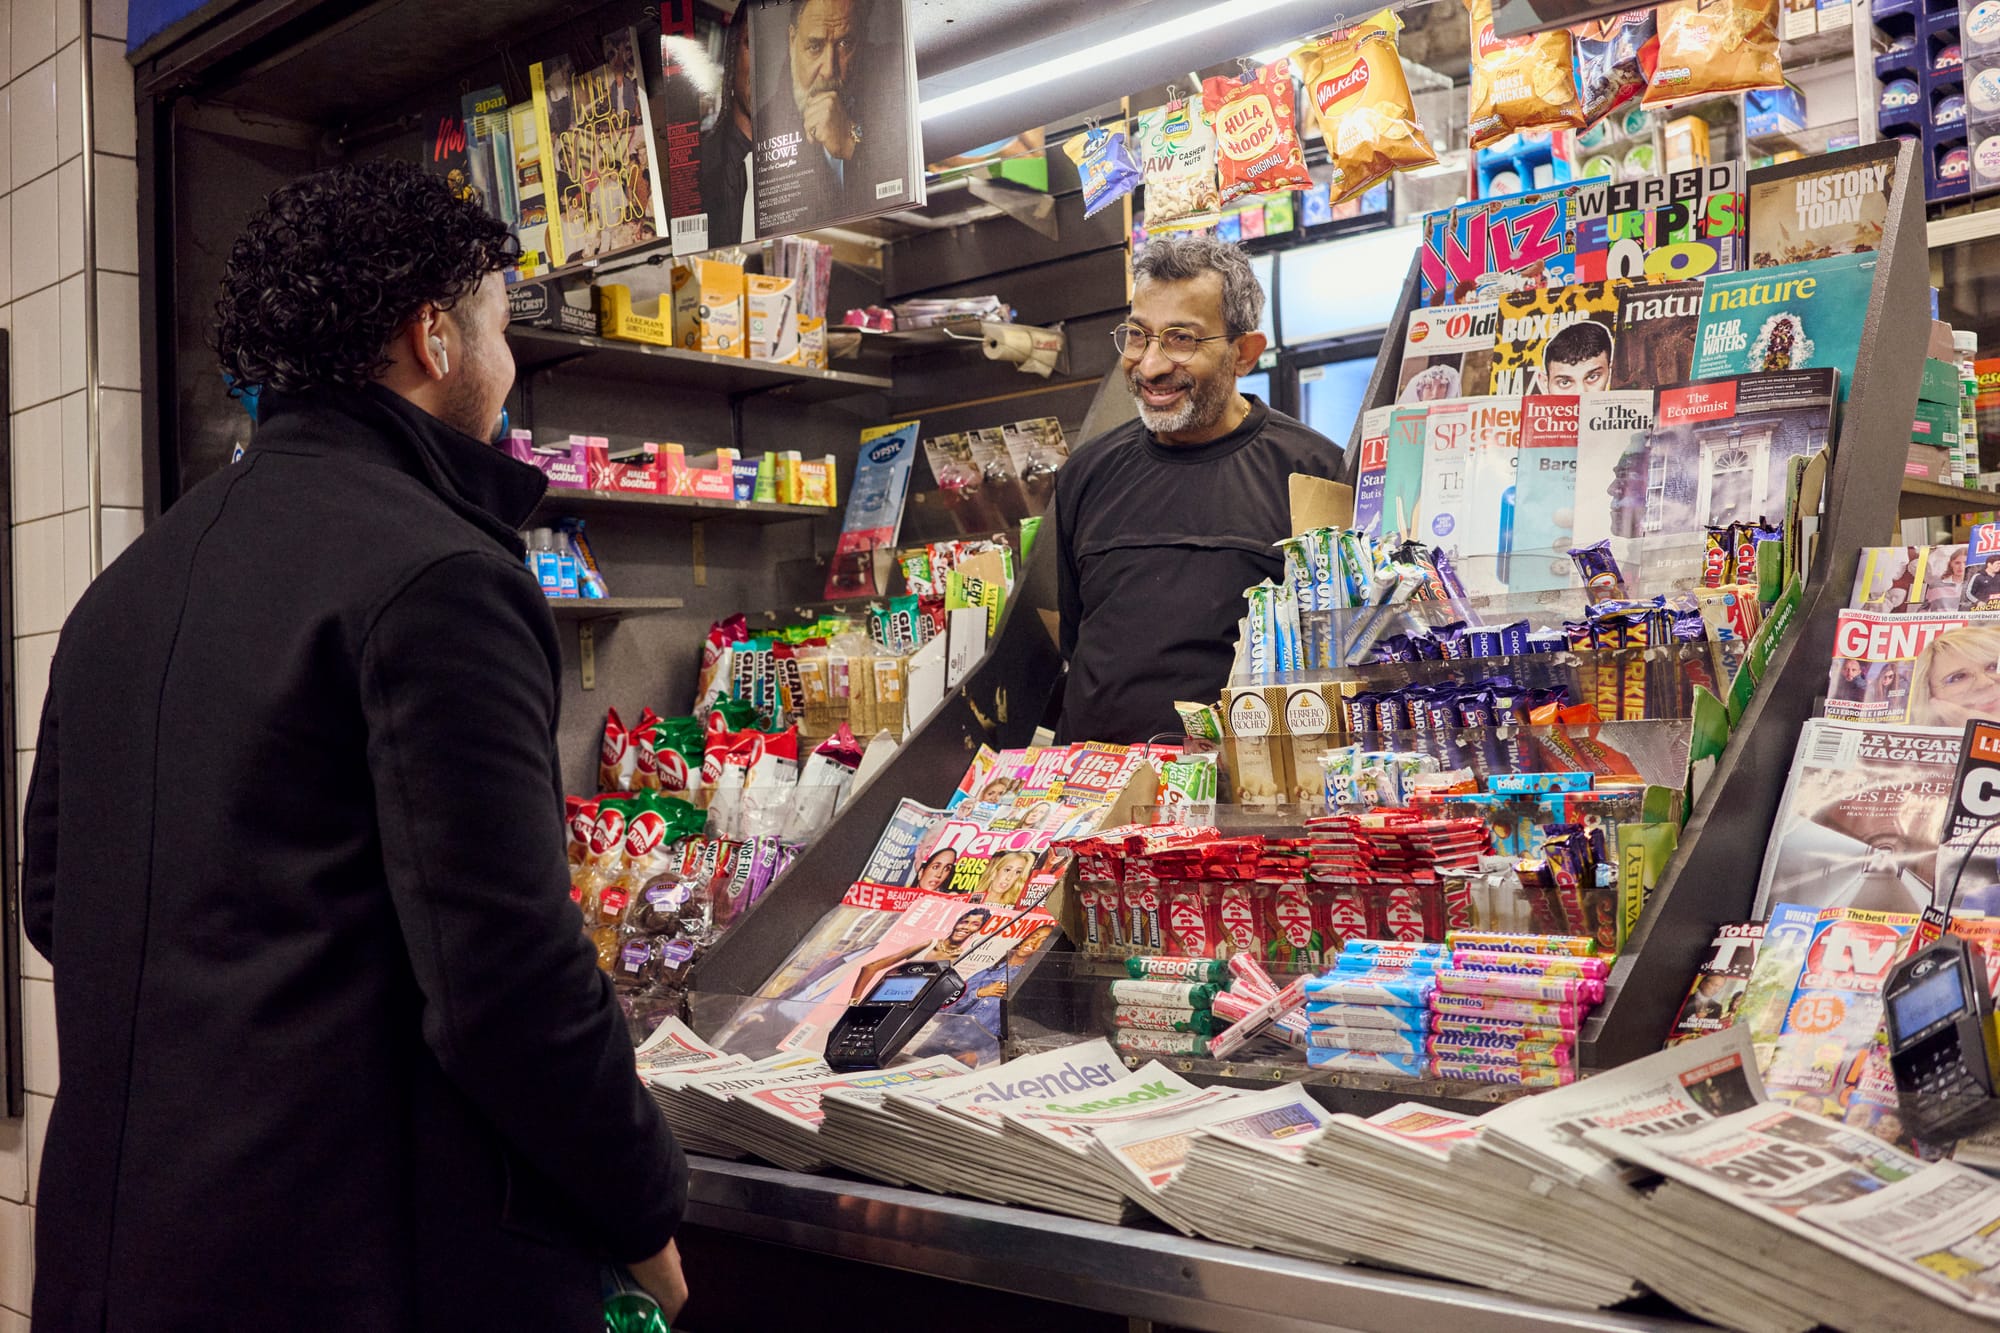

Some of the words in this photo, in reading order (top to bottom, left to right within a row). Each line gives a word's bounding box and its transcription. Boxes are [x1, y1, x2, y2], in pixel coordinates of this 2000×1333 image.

[1317, 65, 1368, 106] WALKERS
[1490, 87, 1532, 105] CHICKEN
[1881, 92, 1918, 105] zone
[1224, 104, 1264, 135] HULA
[757, 131, 802, 152] RUSSELL
[1228, 118, 1273, 154] HOOPS
[560, 110, 630, 184] WAY
[757, 144, 798, 162] CROWE
[1178, 144, 1207, 161] CASHEW
[1184, 155, 1201, 167] NUTS
[1246, 153, 1285, 178] ORIGINAL
[1579, 166, 1731, 217] WIRED
[1796, 164, 1888, 209] HISTORY
[564, 164, 645, 239] BACK
[1796, 196, 1864, 231] TODAY
[1446, 201, 1562, 287] VIZ
[1709, 277, 1817, 313] nature
[626, 316, 664, 330] JAKEMANS
[1436, 318, 1447, 326] The
[1704, 319, 1741, 338] CLEAR
[1702, 334, 1747, 356] WATERS
[1687, 392, 1709, 403] The
[1605, 405, 1637, 419] The
[1667, 401, 1728, 418] Economist
[1534, 418, 1578, 432] Chro
[552, 462, 576, 473] HALLS
[627, 468, 650, 479] HALLS
[732, 465, 757, 477] HALLS
[800, 464, 826, 475] HALLS
[546, 470, 584, 483] Soothers
[620, 477, 657, 490] Soothers
[702, 473, 723, 485] HALLS
[696, 482, 730, 494] Soothers
[1887, 614, 1912, 622] CONSIGLI
[1233, 711, 1266, 721] FERRERO
[1288, 708, 1324, 719] FERRERO
[1412, 700, 1427, 737] DAIRY
[1234, 720, 1267, 730] ROCHER
[1290, 717, 1325, 729] ROCHER
[1432, 710, 1448, 749] DAIRY
[1857, 746, 1959, 764] MAGAZIN
[660, 771, 684, 788] DAYS
[1071, 767, 1115, 789] life!
[1955, 815, 1976, 827] LES
[628, 830, 647, 854] DAYS
[885, 826, 917, 845] White
[879, 838, 911, 858] House
[873, 851, 912, 871] Doctors
[955, 857, 989, 873] CRIS
[867, 864, 887, 881] Tell
[887, 891, 917, 904] BEAUTY
[1019, 898, 1047, 908] WAYNE
[1087, 906, 1098, 944] CHUNKY
[1222, 897, 1253, 946] KitKat
[1276, 890, 1312, 946] KitKat
[1847, 910, 1864, 921] The
[1865, 911, 1886, 923] best
[1888, 913, 1911, 924] NEW
[1132, 907, 1143, 945] CHUNKY
[1172, 899, 1205, 957] KitKat
[1720, 924, 1767, 938] Total
[1454, 942, 1537, 954] mentos
[1820, 926, 1898, 975] tv
[1139, 958, 1198, 977] TREBOR
[1371, 956, 1413, 969] TREBOR
[1461, 962, 1544, 976] mentos
[884, 986, 914, 996] Elavon
[1438, 996, 1483, 1009] mentos
[1435, 1035, 1517, 1051] mentos
[1440, 1067, 1522, 1085] mentos
